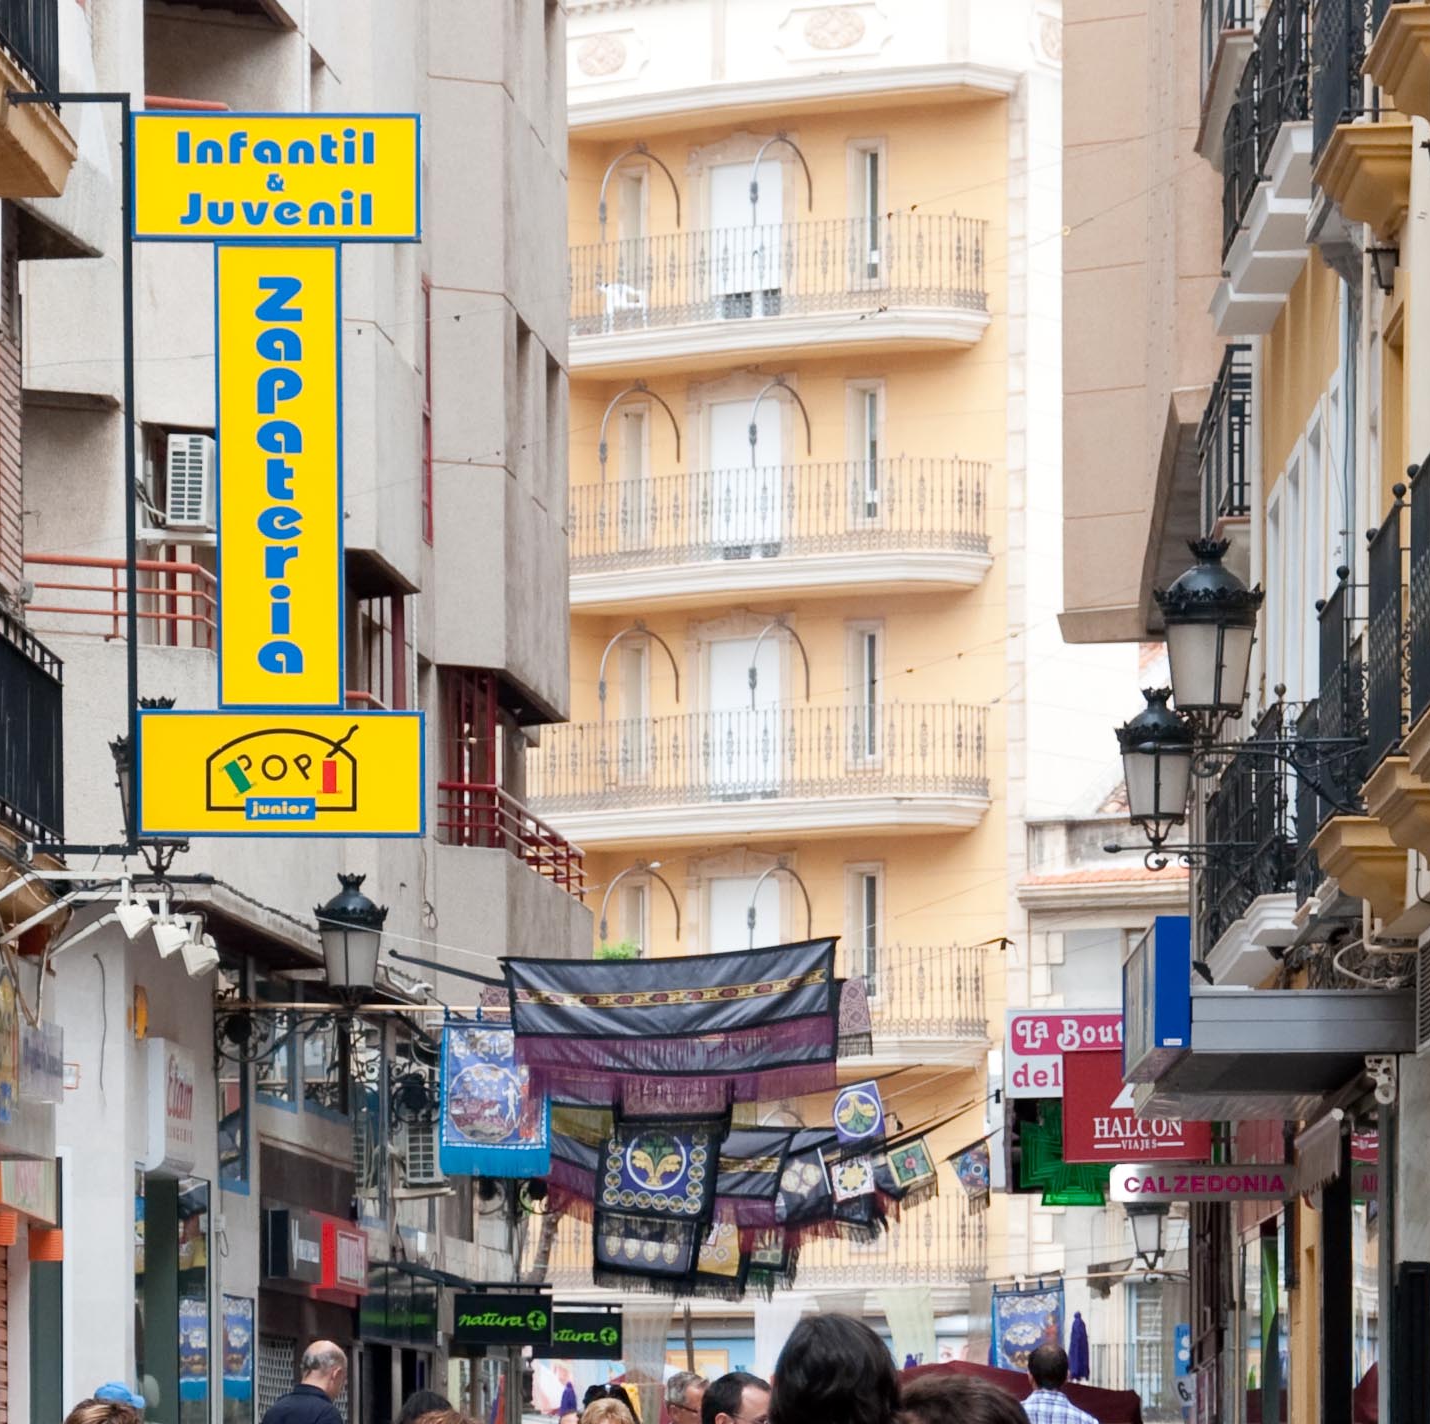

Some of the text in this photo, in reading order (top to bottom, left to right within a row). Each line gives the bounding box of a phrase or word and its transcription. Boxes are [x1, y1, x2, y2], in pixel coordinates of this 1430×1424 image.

[177, 128, 374, 164] Infantil
[266, 173, 285, 192] &
[179, 192, 373, 226] Juvenil
[250, 800, 310, 818] junior
[1015, 1019, 1050, 1050] La
[1012, 1062, 1061, 1088] del
[1120, 1139, 1158, 1152] VIAJES
[1124, 1175, 1287, 1195] CALZEDONIA
[458, 1312, 526, 1328] natura
